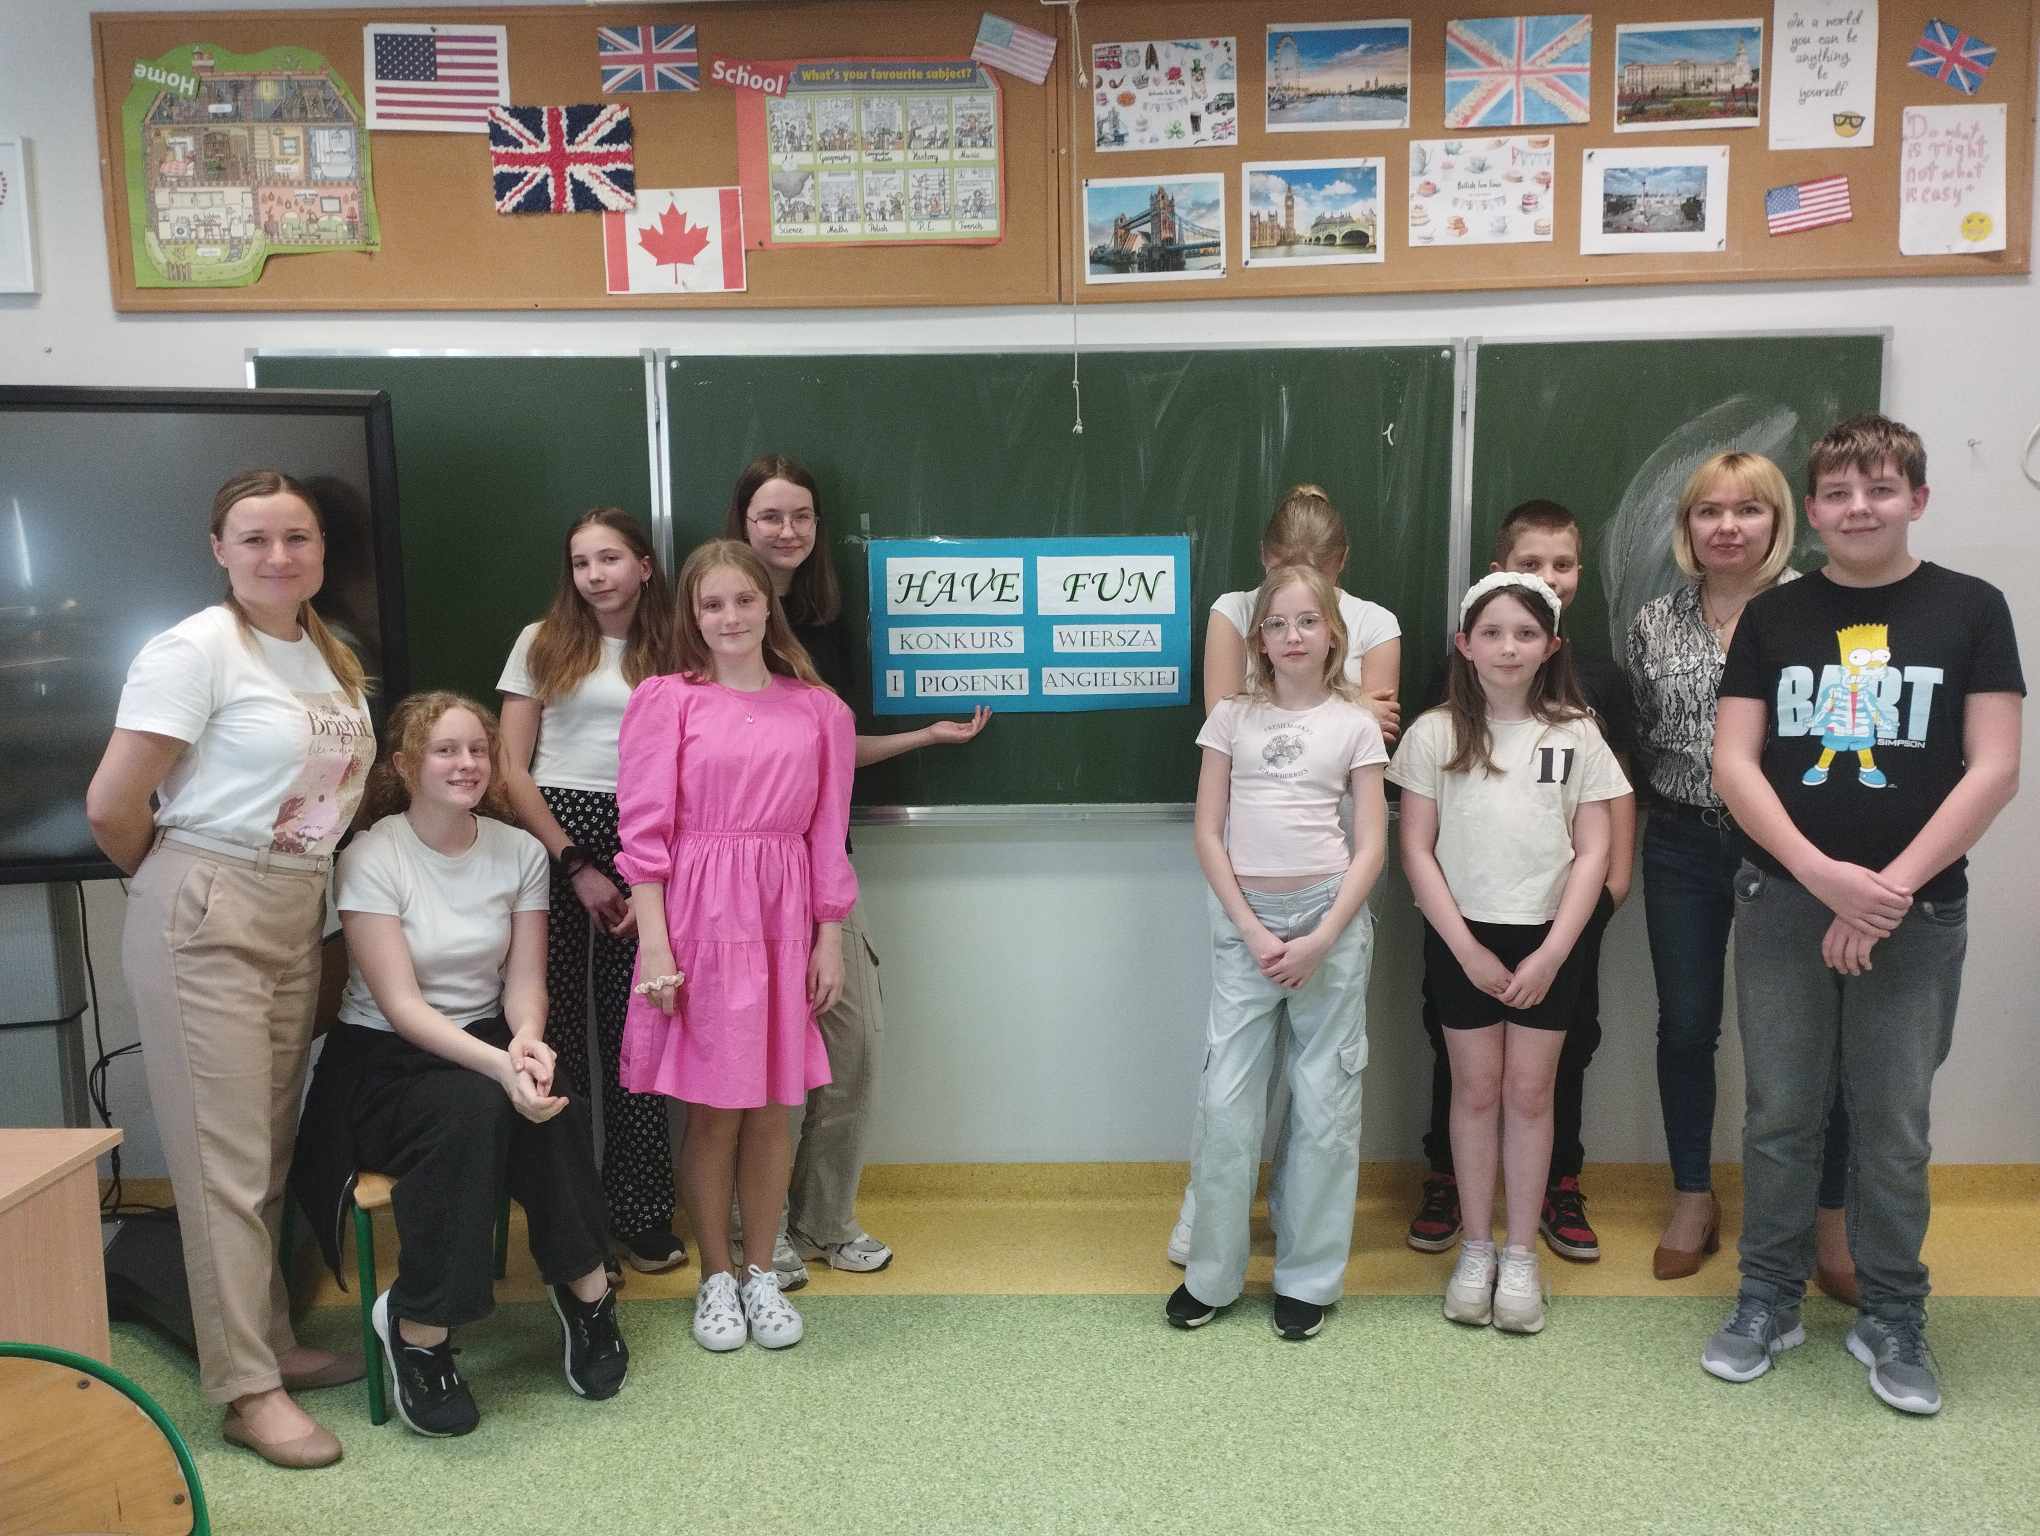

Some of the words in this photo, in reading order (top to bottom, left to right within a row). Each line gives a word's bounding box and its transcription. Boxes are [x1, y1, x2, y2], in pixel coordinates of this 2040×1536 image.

[1811, 18, 1819, 28] a
[1825, 9, 1864, 27] world
[1790, 36, 1811, 53] you
[1818, 35, 1839, 45] can
[1847, 28, 1859, 43] be
[1795, 48, 1851, 70] anything
[134, 63, 196, 95] Home
[711, 60, 784, 94] School
[801, 67, 840, 81] What's
[842, 70, 867, 82] your
[871, 67, 923, 81] favourite
[926, 67, 972, 82] subject?
[1817, 64, 1829, 80] be
[1799, 81, 1849, 105] yourself
[1905, 160, 1939, 182] not
[895, 568, 1020, 607] HAVE
[1061, 568, 1166, 603] FUN
[899, 631, 1014, 650] KONKURS
[1058, 629, 1157, 648] WIERSZA
[920, 673, 1024, 693] PIOSENKI
[1043, 670, 1176, 688] ANGIELSKIEJ
[306, 710, 372, 745] Bright
[1877, 738, 1926, 749] SIMPSON
